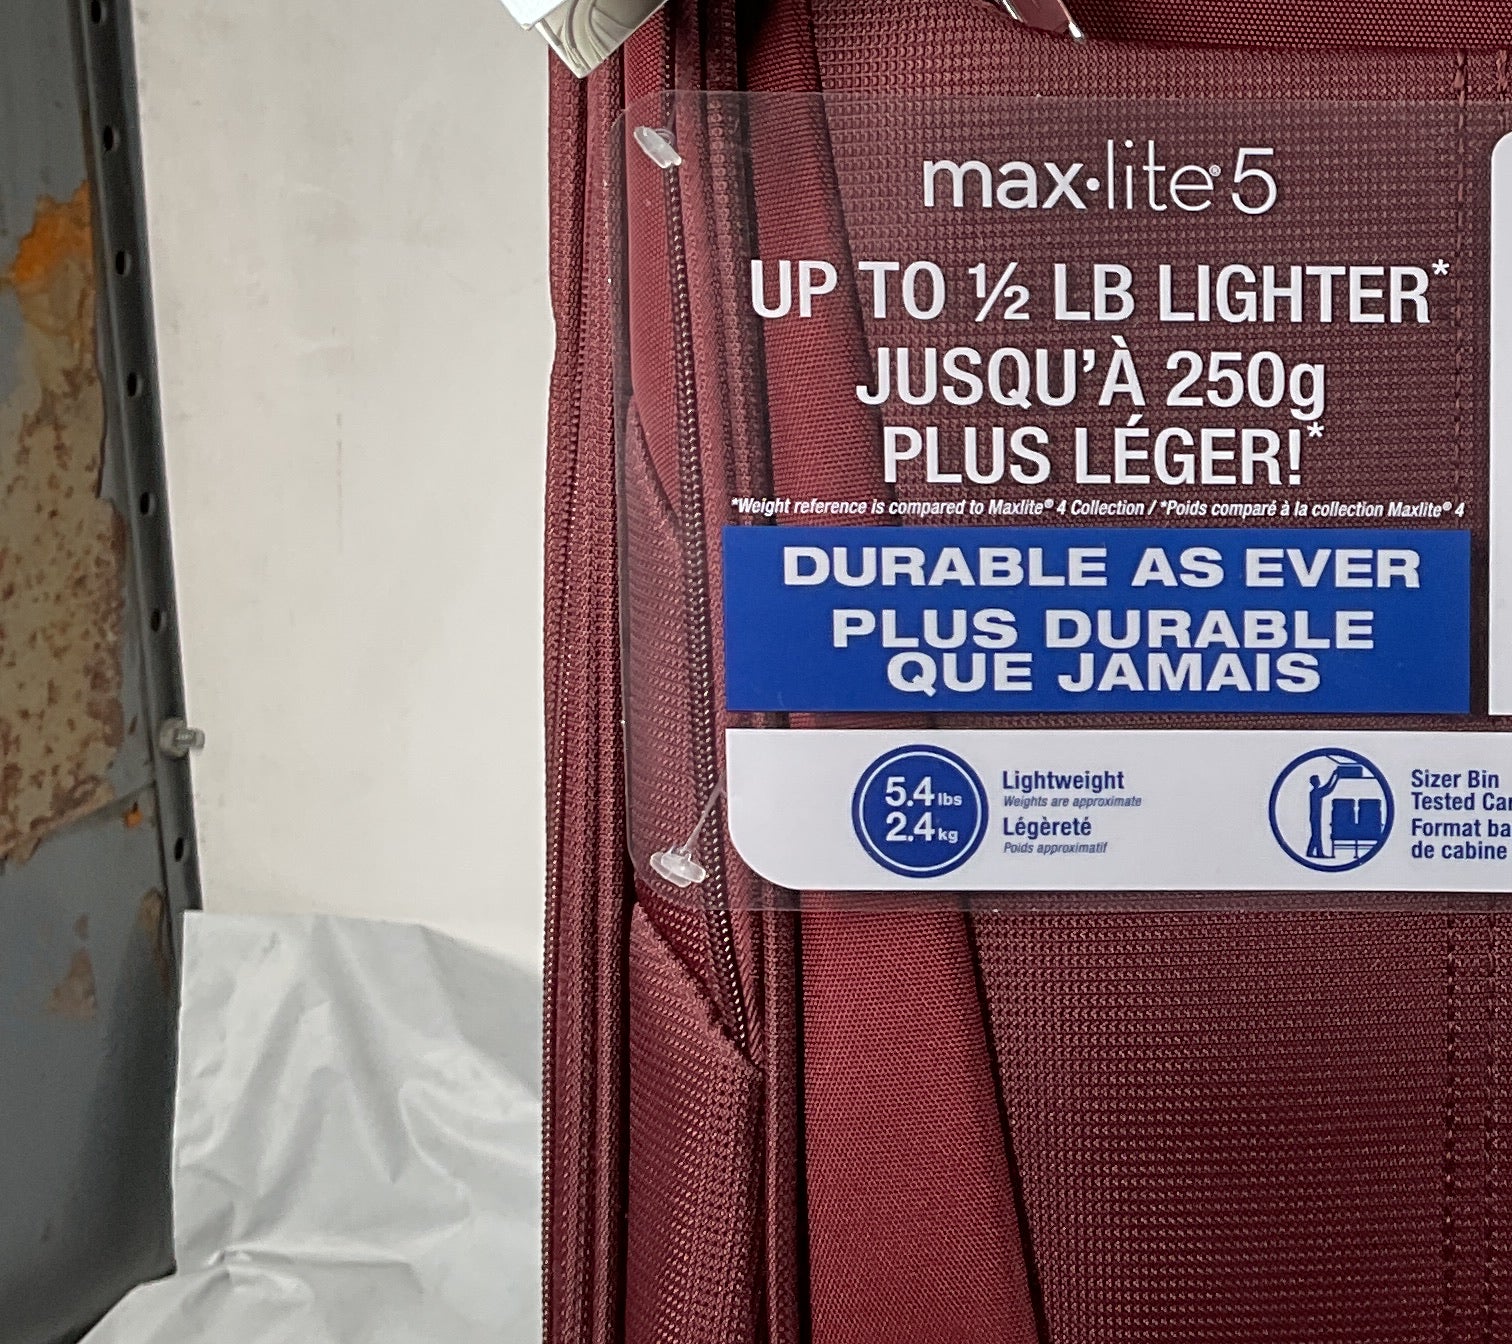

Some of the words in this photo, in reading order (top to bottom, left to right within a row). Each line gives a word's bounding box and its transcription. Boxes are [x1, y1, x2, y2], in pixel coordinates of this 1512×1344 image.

[1232, 147, 1278, 215] 5
[750, 260, 838, 319] UP
[858, 261, 946, 321] TO
[1055, 264, 1135, 323] LB
[1166, 351, 1326, 420] 250g
[883, 427, 1051, 485] PLUS
[794, 499, 867, 515] reference
[871, 500, 884, 515] is
[888, 500, 965, 518] compared
[969, 501, 985, 516] to
[1056, 501, 1067, 516] 4
[1070, 499, 1144, 517] Collection
[1149, 500, 1157, 516] /
[1211, 501, 1277, 519] comparé
[1280, 501, 1290, 517] à
[1294, 501, 1308, 517] la
[1312, 502, 1384, 517] collection
[1454, 503, 1465, 518] 4
[783, 546, 1108, 587] DURABLE
[1131, 547, 1225, 588] AS
[1245, 548, 1421, 589] EVER
[832, 608, 1018, 649] PLUS
[1046, 609, 1374, 649] DURABLE
[886, 651, 1033, 697] QUE
[1057, 652, 1321, 693] JAMAIS
[885, 776, 935, 807] 5.4
[937, 792, 963, 807] lbs
[1002, 770, 1125, 794] Lightweight
[1411, 769, 1461, 788] Sizer
[1468, 769, 1500, 789] Bin
[1003, 795, 1048, 809] Weights
[1050, 797, 1069, 808] are
[1072, 795, 1142, 810] approximate
[1411, 792, 1475, 811] Tested
[885, 811, 935, 842] 2.4
[938, 828, 959, 844] kg
[1003, 816, 1091, 840] Légèreté
[1411, 818, 1481, 837] Format
[1003, 841, 1034, 854] Poids
[1036, 841, 1107, 856] approximatif
[1411, 841, 1435, 859] de
[1441, 841, 1507, 860] cabine
